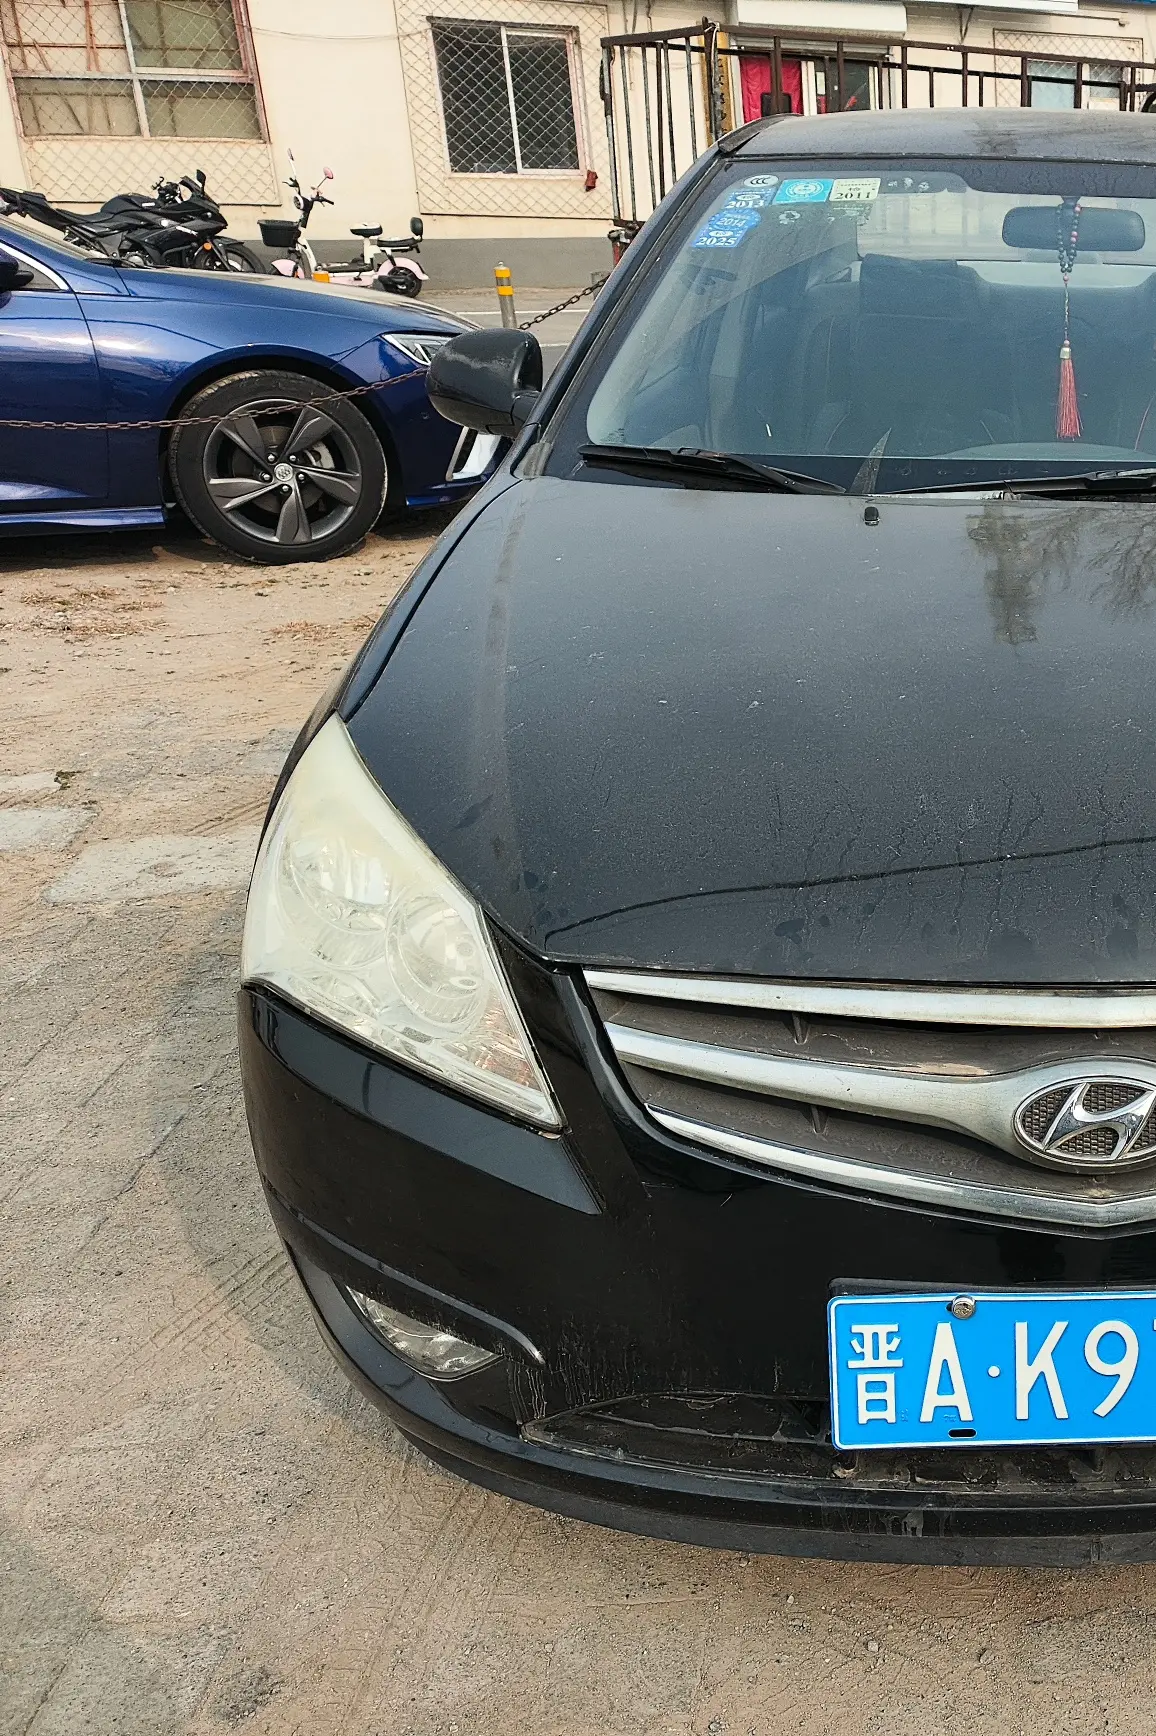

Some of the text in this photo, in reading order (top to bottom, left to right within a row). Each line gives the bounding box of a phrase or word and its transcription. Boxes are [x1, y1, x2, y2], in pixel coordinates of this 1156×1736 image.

[835, 192, 872, 200] 2011
[725, 200, 765, 209] 2013
[715, 217, 747, 227] 2014
[696, 237, 737, 246] 2025
